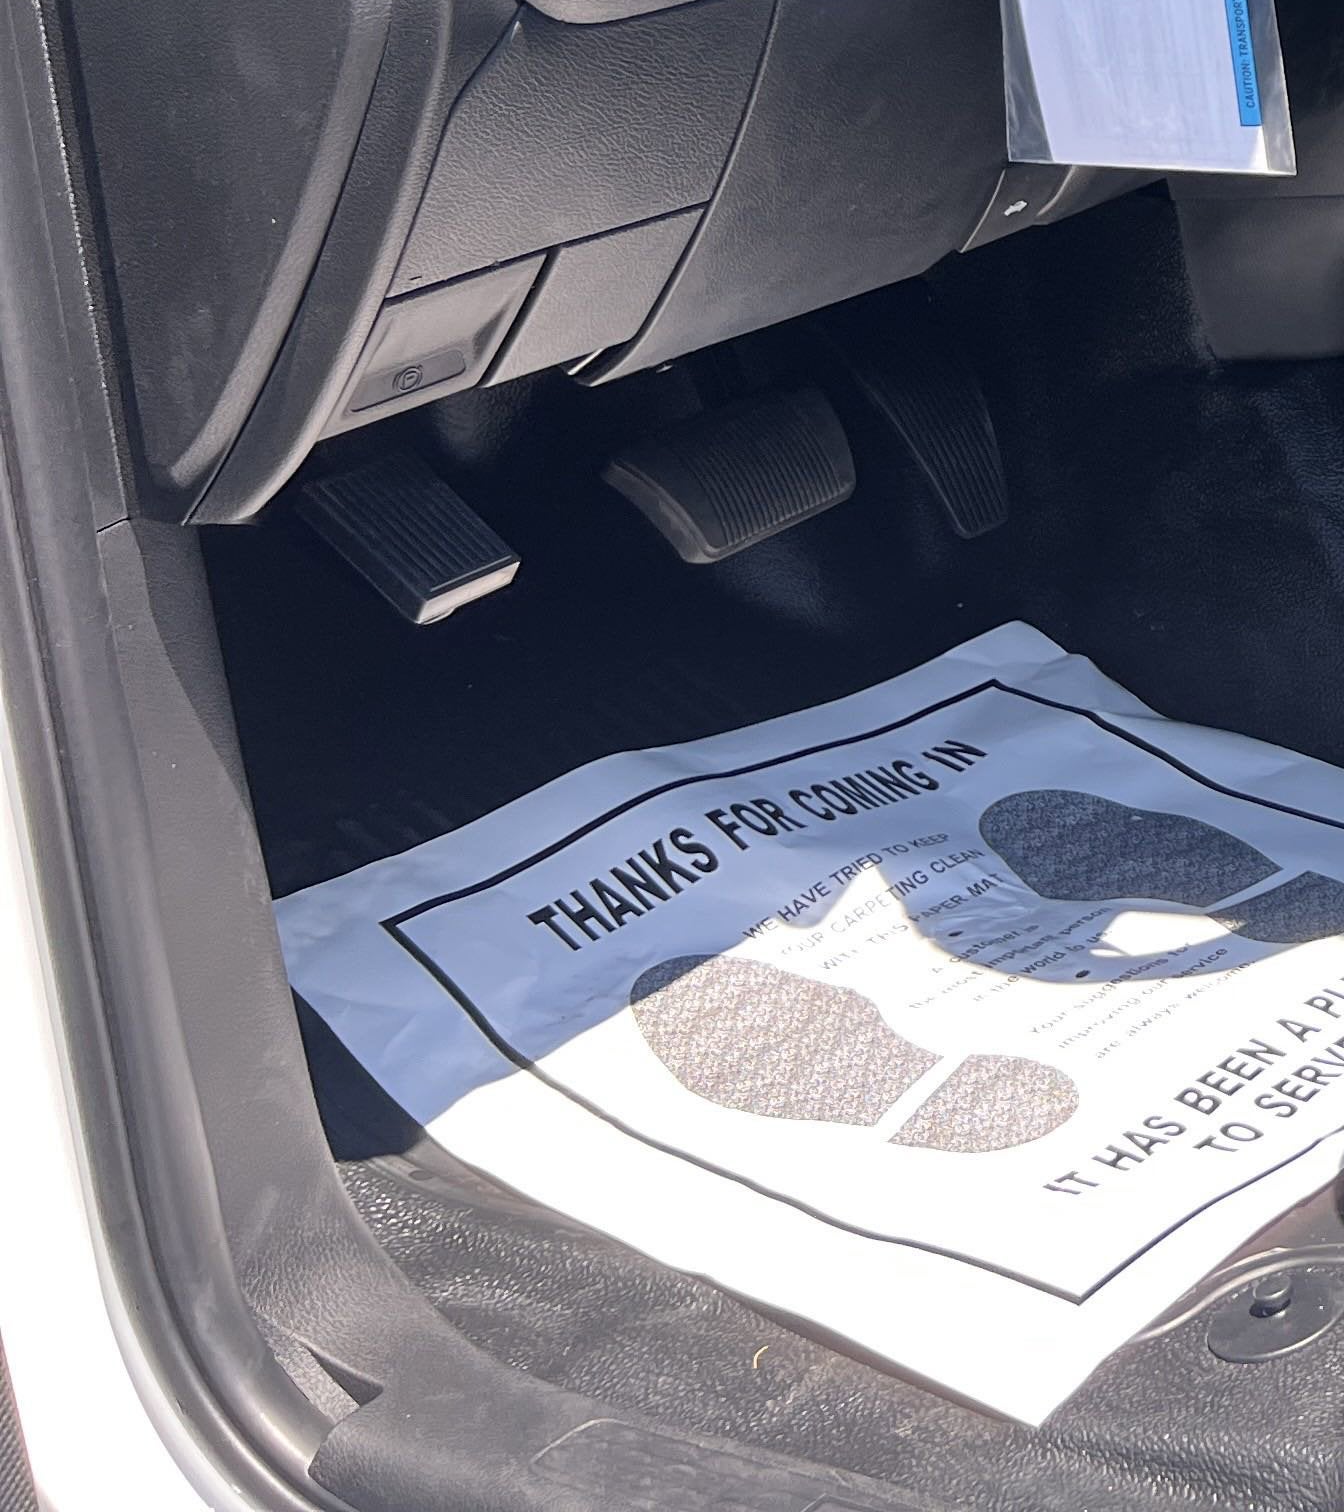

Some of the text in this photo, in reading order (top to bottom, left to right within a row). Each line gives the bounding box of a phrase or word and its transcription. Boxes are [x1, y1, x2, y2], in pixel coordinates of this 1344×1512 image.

[526, 739, 988, 951] THANKS FOR COMING IN
[743, 831, 950, 940] WE HAVE TRIED TO KEEP
[831, 870, 930, 935] CARPETING
[929, 848, 985, 874] CLEAN
[908, 894, 968, 924] PAPER
[966, 872, 1005, 898] MAT
[1020, 950, 1067, 975] world
[1170, 947, 1229, 979] service
[1043, 1170, 1101, 1195] IT
[1092, 1115, 1188, 1171] HAS
[1173, 1037, 1288, 1116] BEEN
[1276, 1018, 1322, 1043] A
[1192, 1121, 1265, 1153] TO
